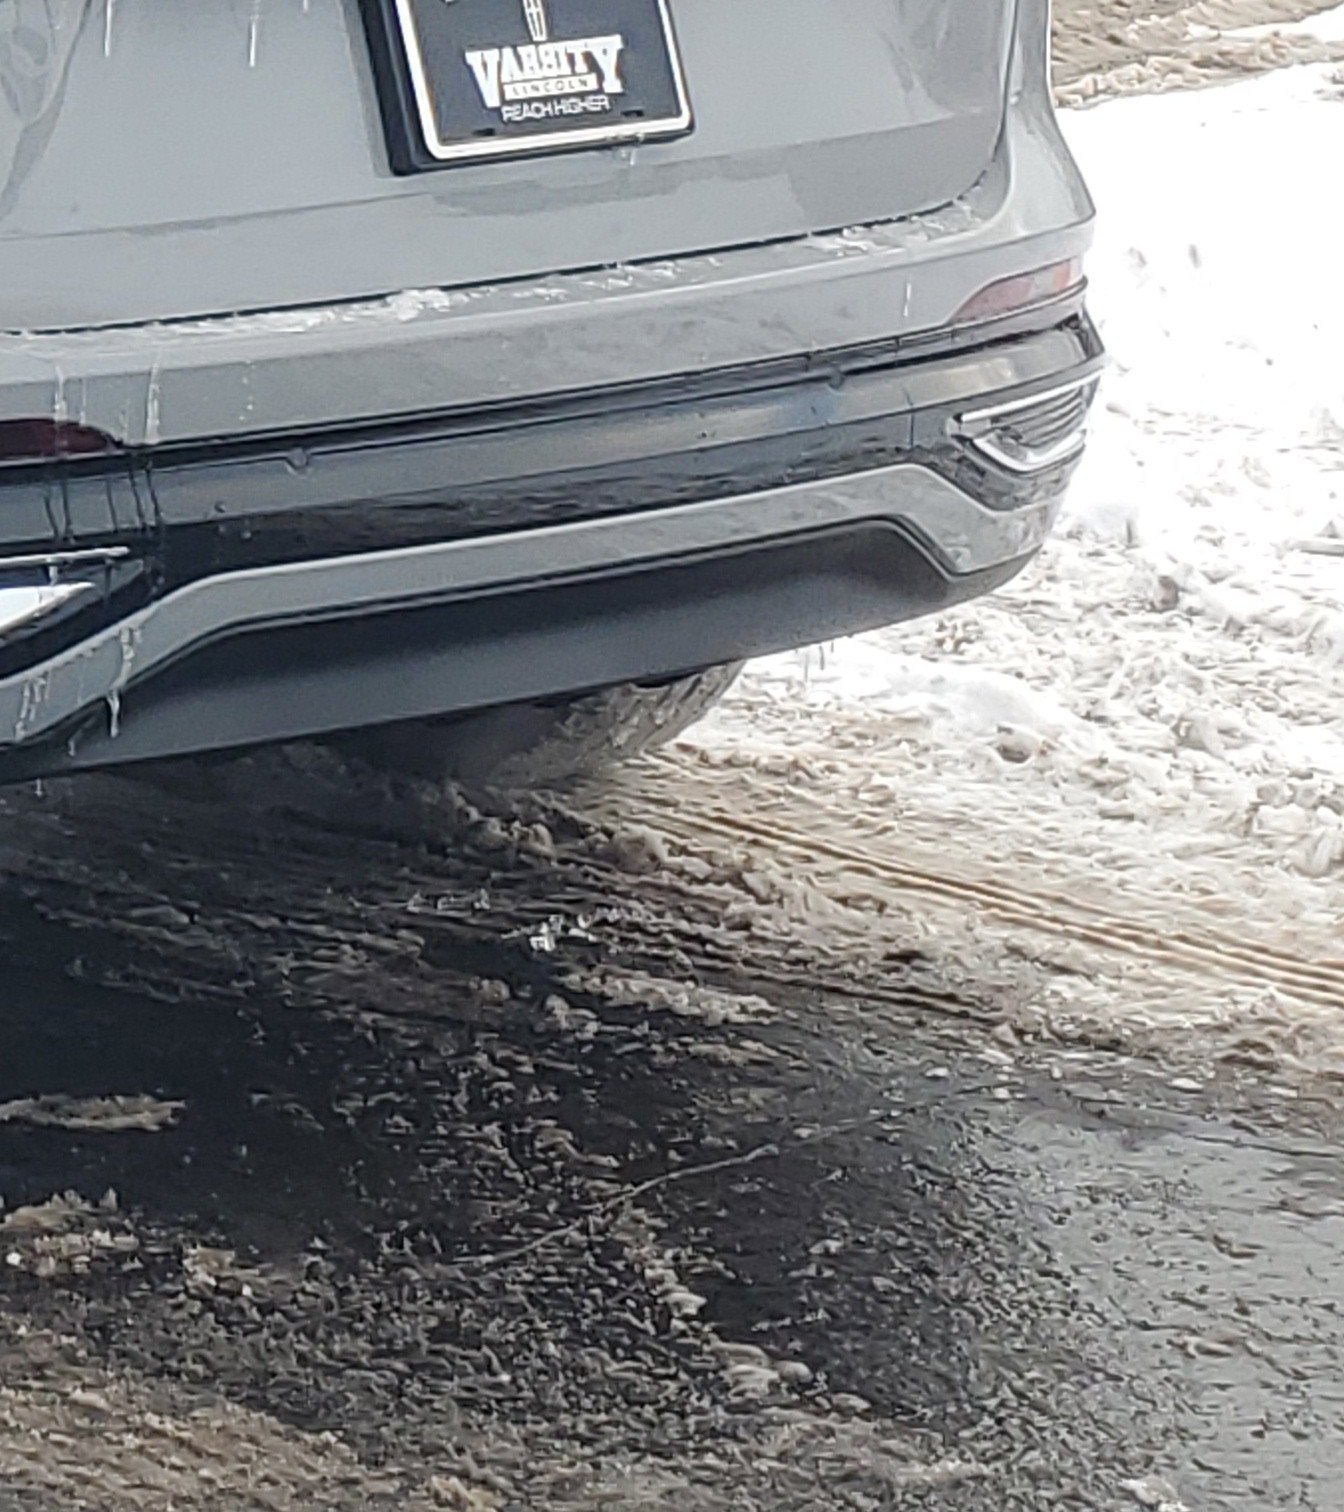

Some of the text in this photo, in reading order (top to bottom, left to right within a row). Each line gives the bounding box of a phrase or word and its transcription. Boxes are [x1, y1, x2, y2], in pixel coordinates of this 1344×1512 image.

[464, 34, 624, 109] VARSITY
[511, 77, 590, 96] LINCOLN
[501, 94, 611, 124] REACH HIGHER
